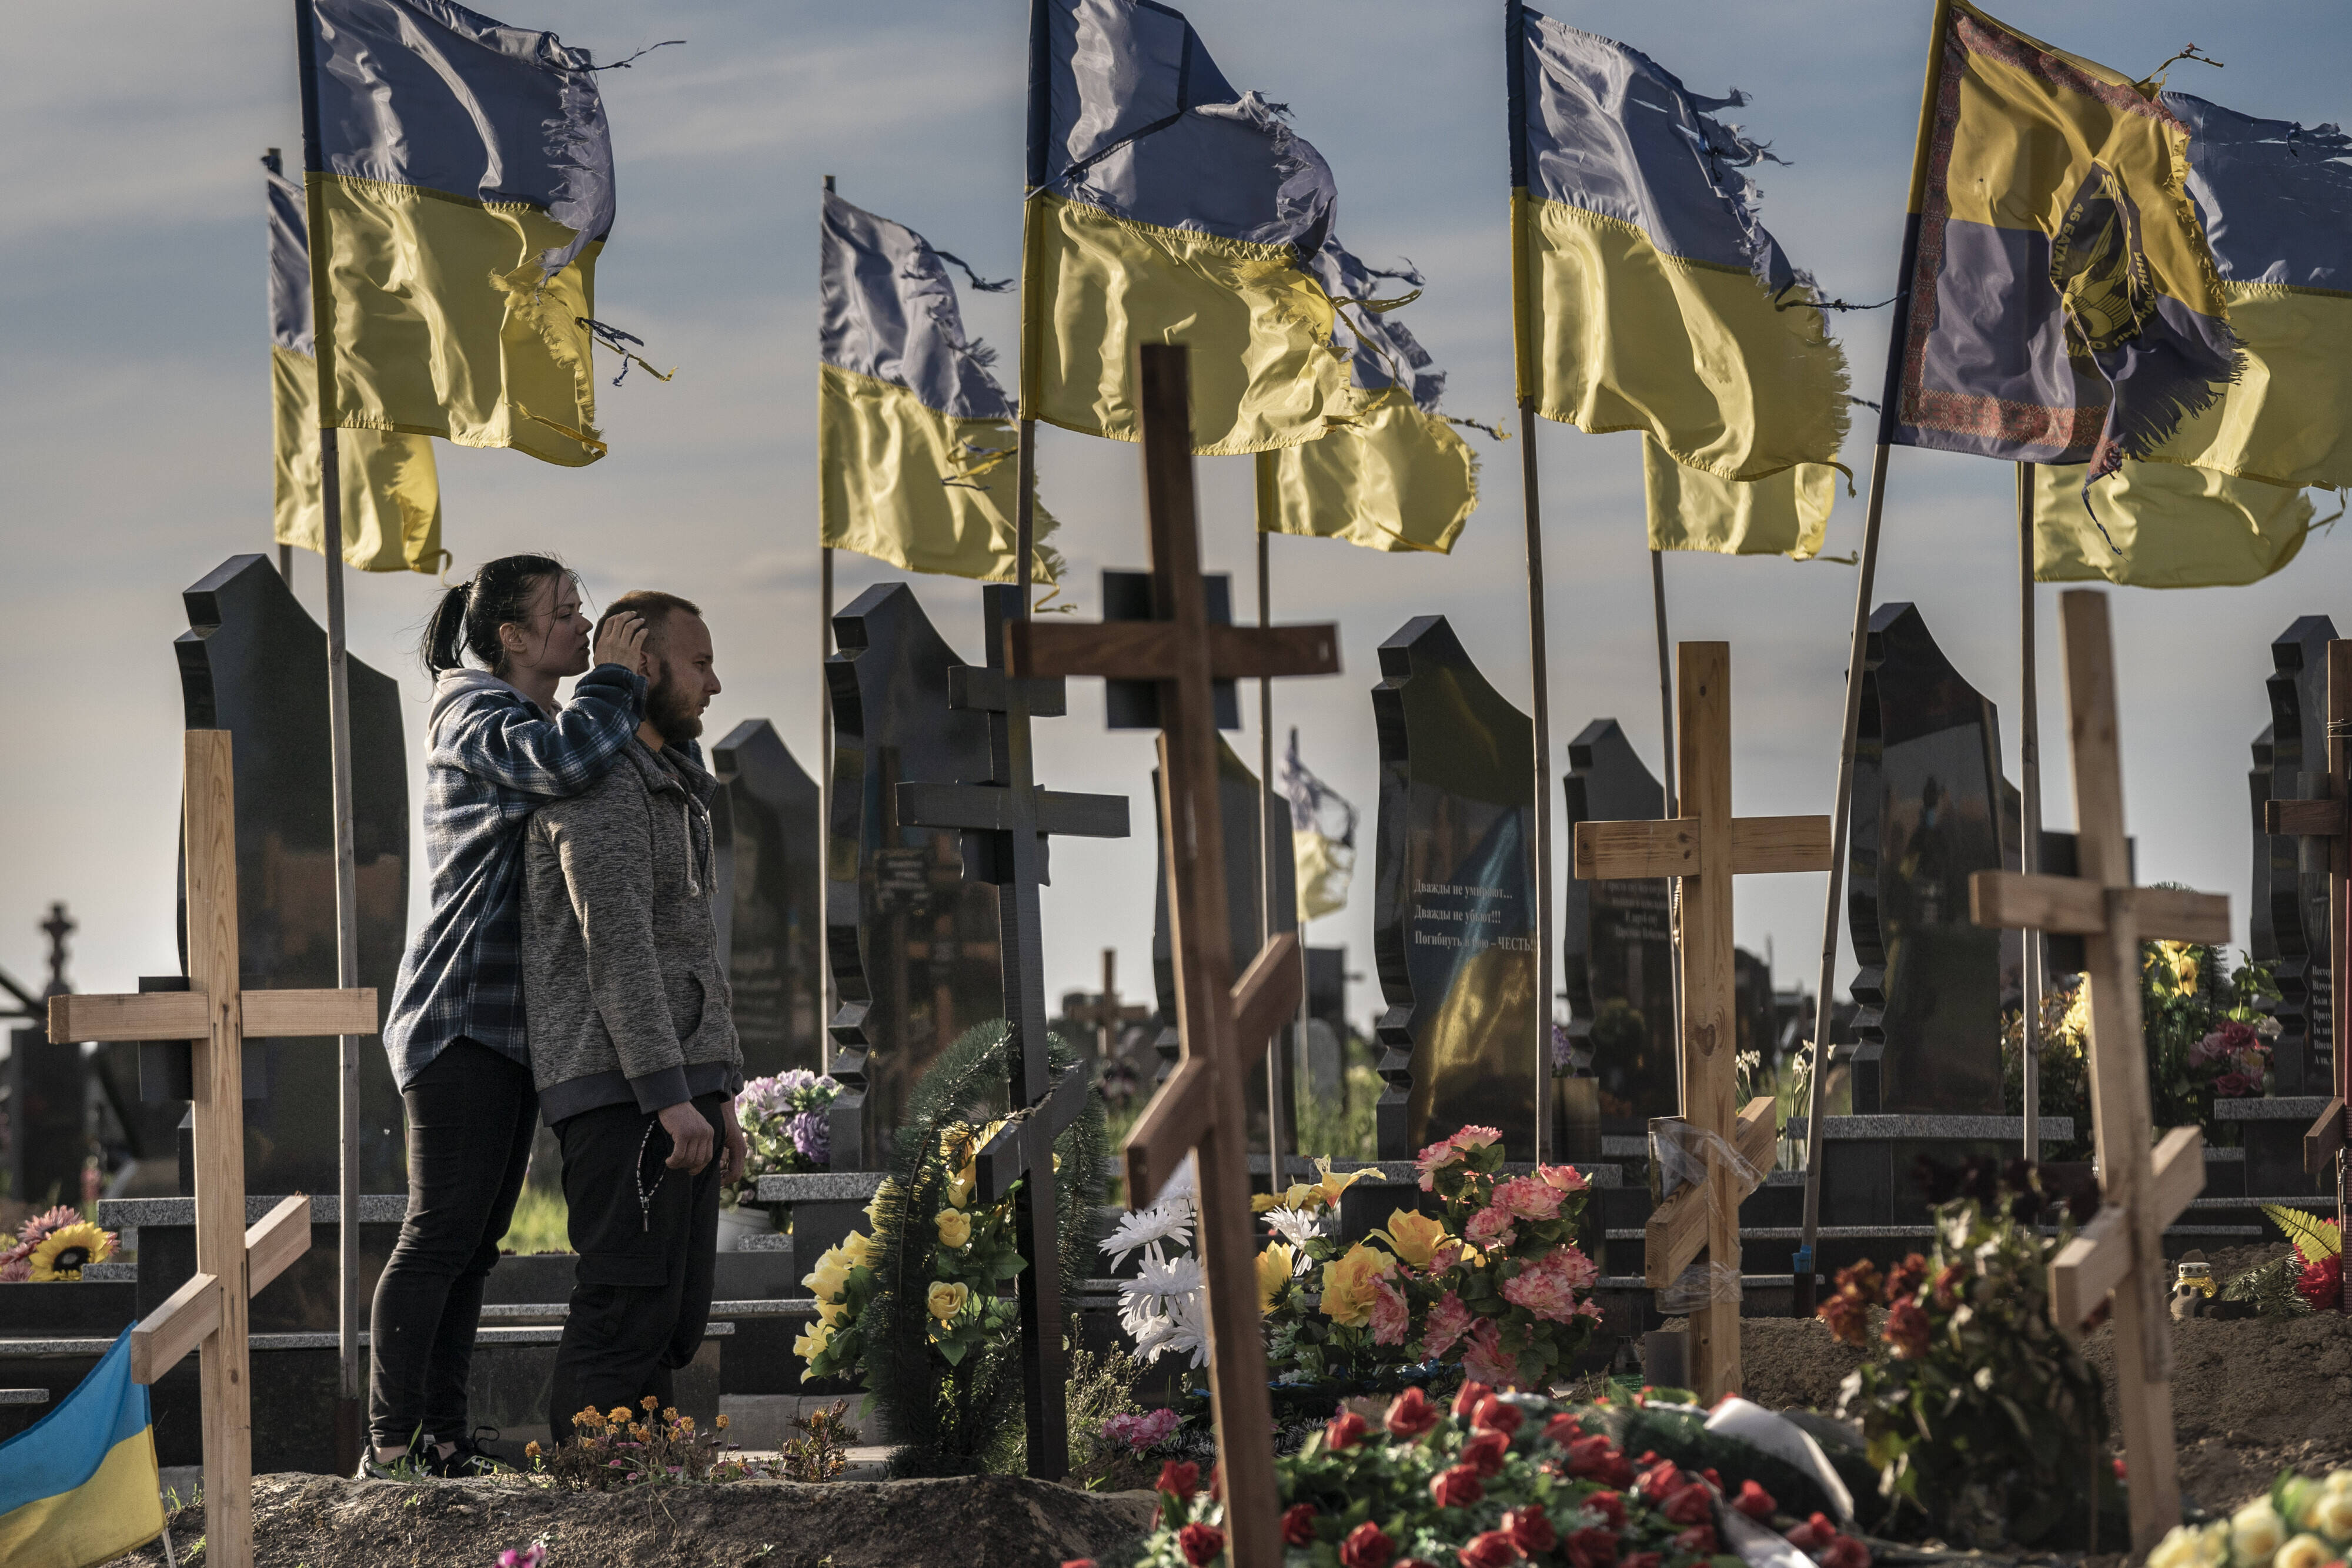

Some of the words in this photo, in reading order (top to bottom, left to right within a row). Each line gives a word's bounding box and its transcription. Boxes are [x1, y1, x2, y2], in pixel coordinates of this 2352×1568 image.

[2069, 202, 2084, 222] 46
[2050, 222, 2076, 282] БАТАЛЬ
[1414, 880, 1451, 895] Дважды
[1454, 884, 1463, 895] не
[1414, 905, 1451, 921] Дважды
[1454, 911, 1463, 921] не
[1465, 909, 1501, 924] убьют!!!
[1415, 931, 1462, 950] Погибнуть
[2313, 1009, 2332, 1022] Приту
